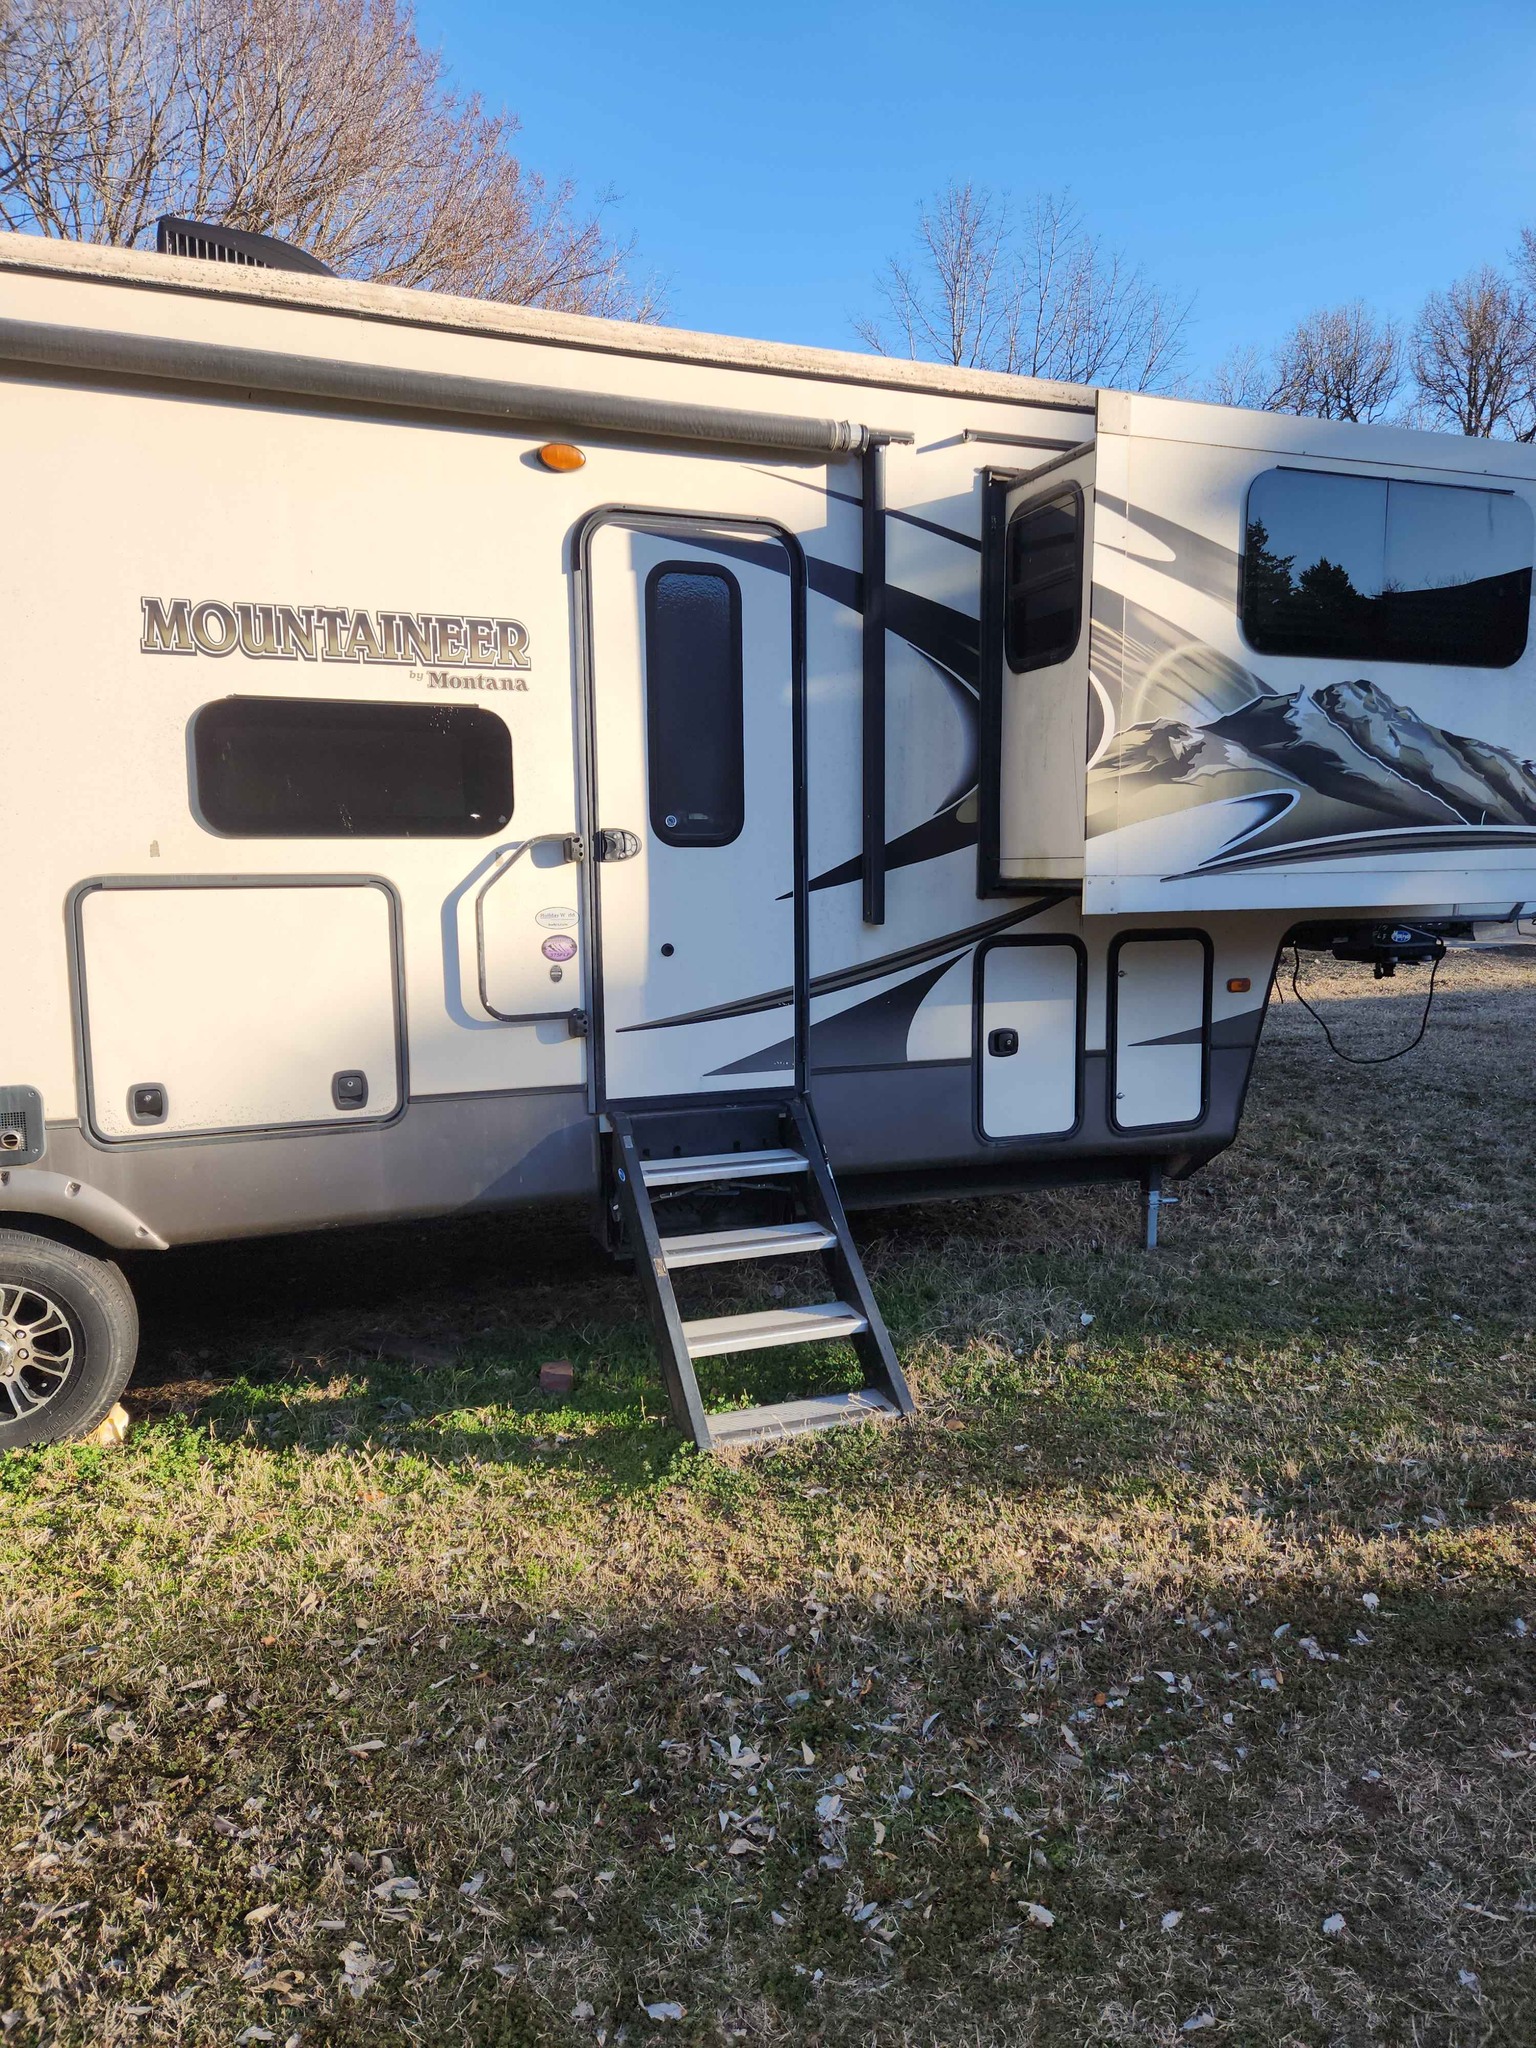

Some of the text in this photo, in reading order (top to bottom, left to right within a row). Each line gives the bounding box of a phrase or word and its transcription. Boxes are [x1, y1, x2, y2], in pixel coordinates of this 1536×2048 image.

[140, 596, 532, 671] MOUNTAINEER
[409, 670, 530, 692] by Montana
